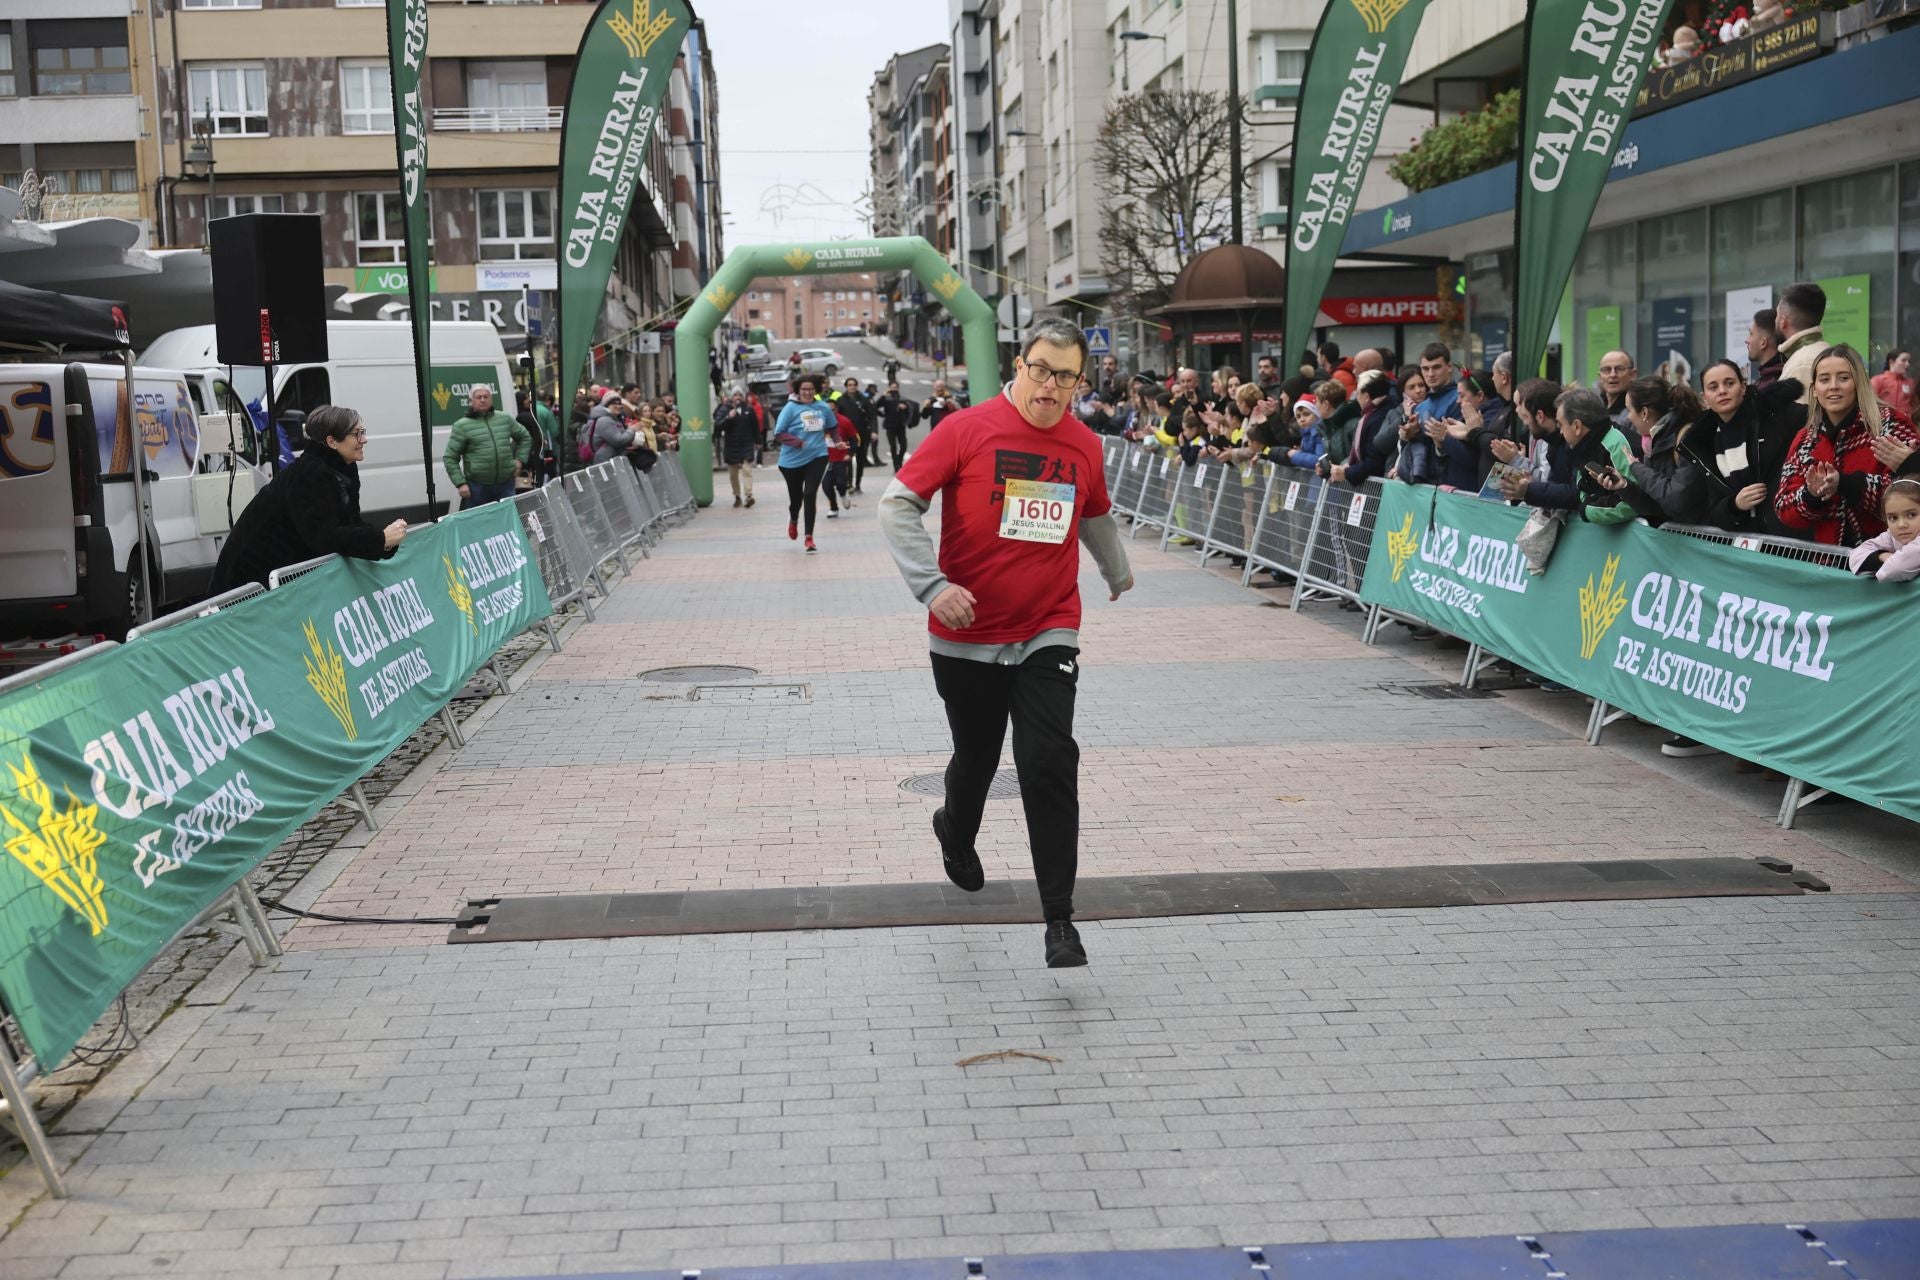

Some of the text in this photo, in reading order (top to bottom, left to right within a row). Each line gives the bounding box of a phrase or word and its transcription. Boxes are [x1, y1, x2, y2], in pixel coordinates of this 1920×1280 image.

[564, 66, 648, 268] CAJA RURAL
[1294, 42, 1387, 252] CAJA RURAL
[1328, 82, 1392, 226] DE ASTURIAS
[1529, 75, 1600, 193] CAJA
[1582, 109, 1622, 156] DE
[600, 105, 654, 244] DE ASTURIAS
[484, 269, 531, 279] Podemos
[815, 246, 884, 260] CAJA RURAL
[1361, 301, 1439, 318] MAPFR
[1011, 519, 1065, 530] JESUS VALLINA
[1018, 498, 1063, 521] 1610
[1456, 534, 1529, 594] RURAL
[333, 577, 435, 668] CAJA RURAL
[1631, 571, 1835, 682] CAJA RURAL
[358, 646, 432, 720] DE ASTURIAS
[1613, 635, 1752, 714] DE ASTURIAS
[83, 666, 276, 820] CAJA RURAL
